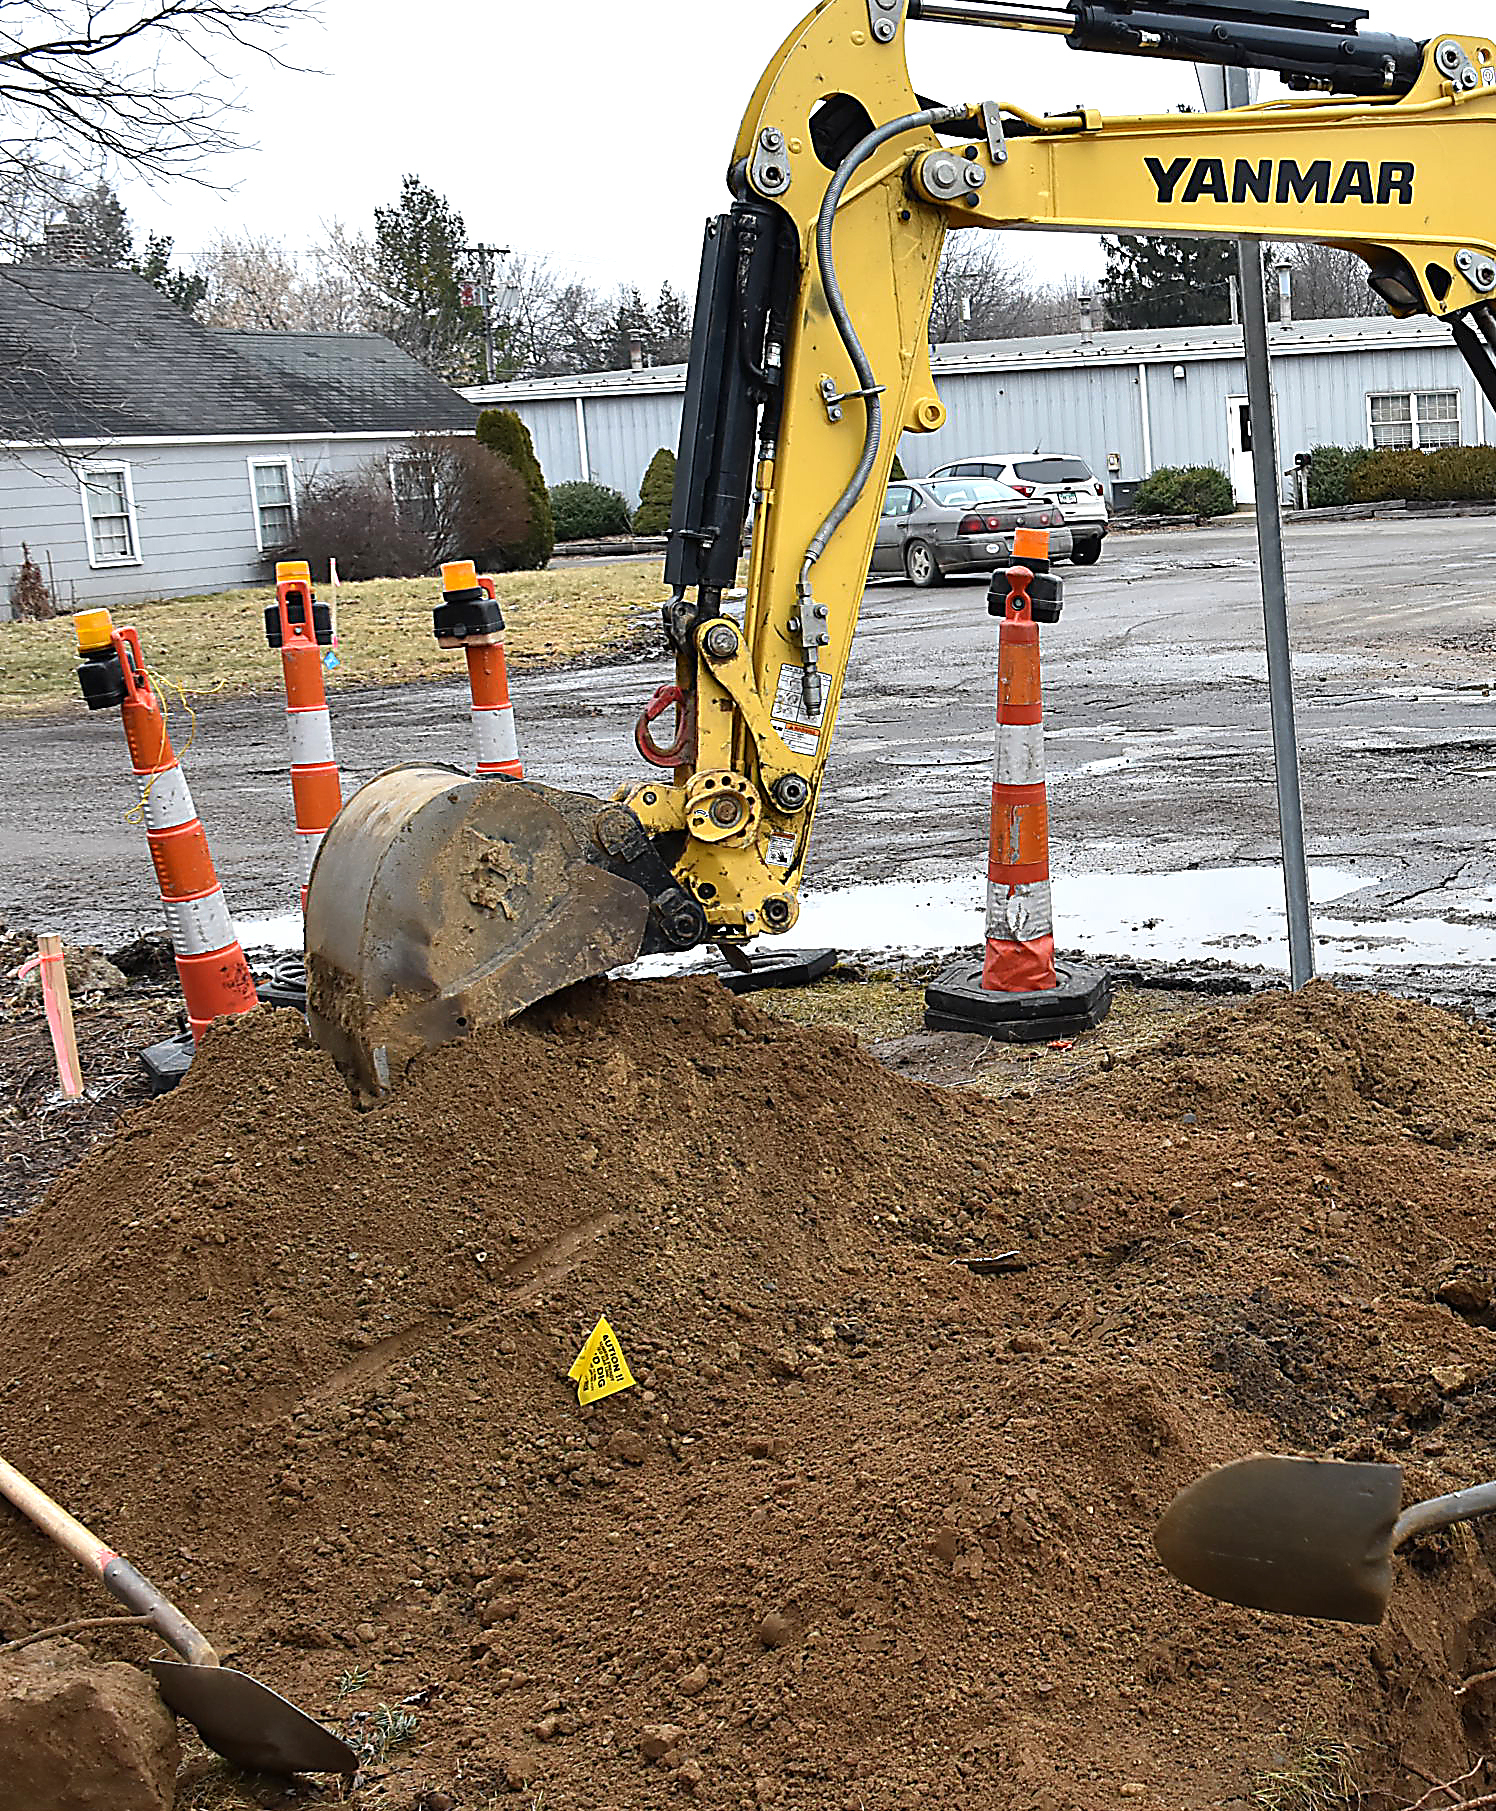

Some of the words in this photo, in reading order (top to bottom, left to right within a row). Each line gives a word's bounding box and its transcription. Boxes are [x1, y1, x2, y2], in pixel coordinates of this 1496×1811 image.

[1143, 157, 1414, 204] YANMAR
[602, 1334, 621, 1372] AUTION
[596, 1366, 606, 1388] DIG
